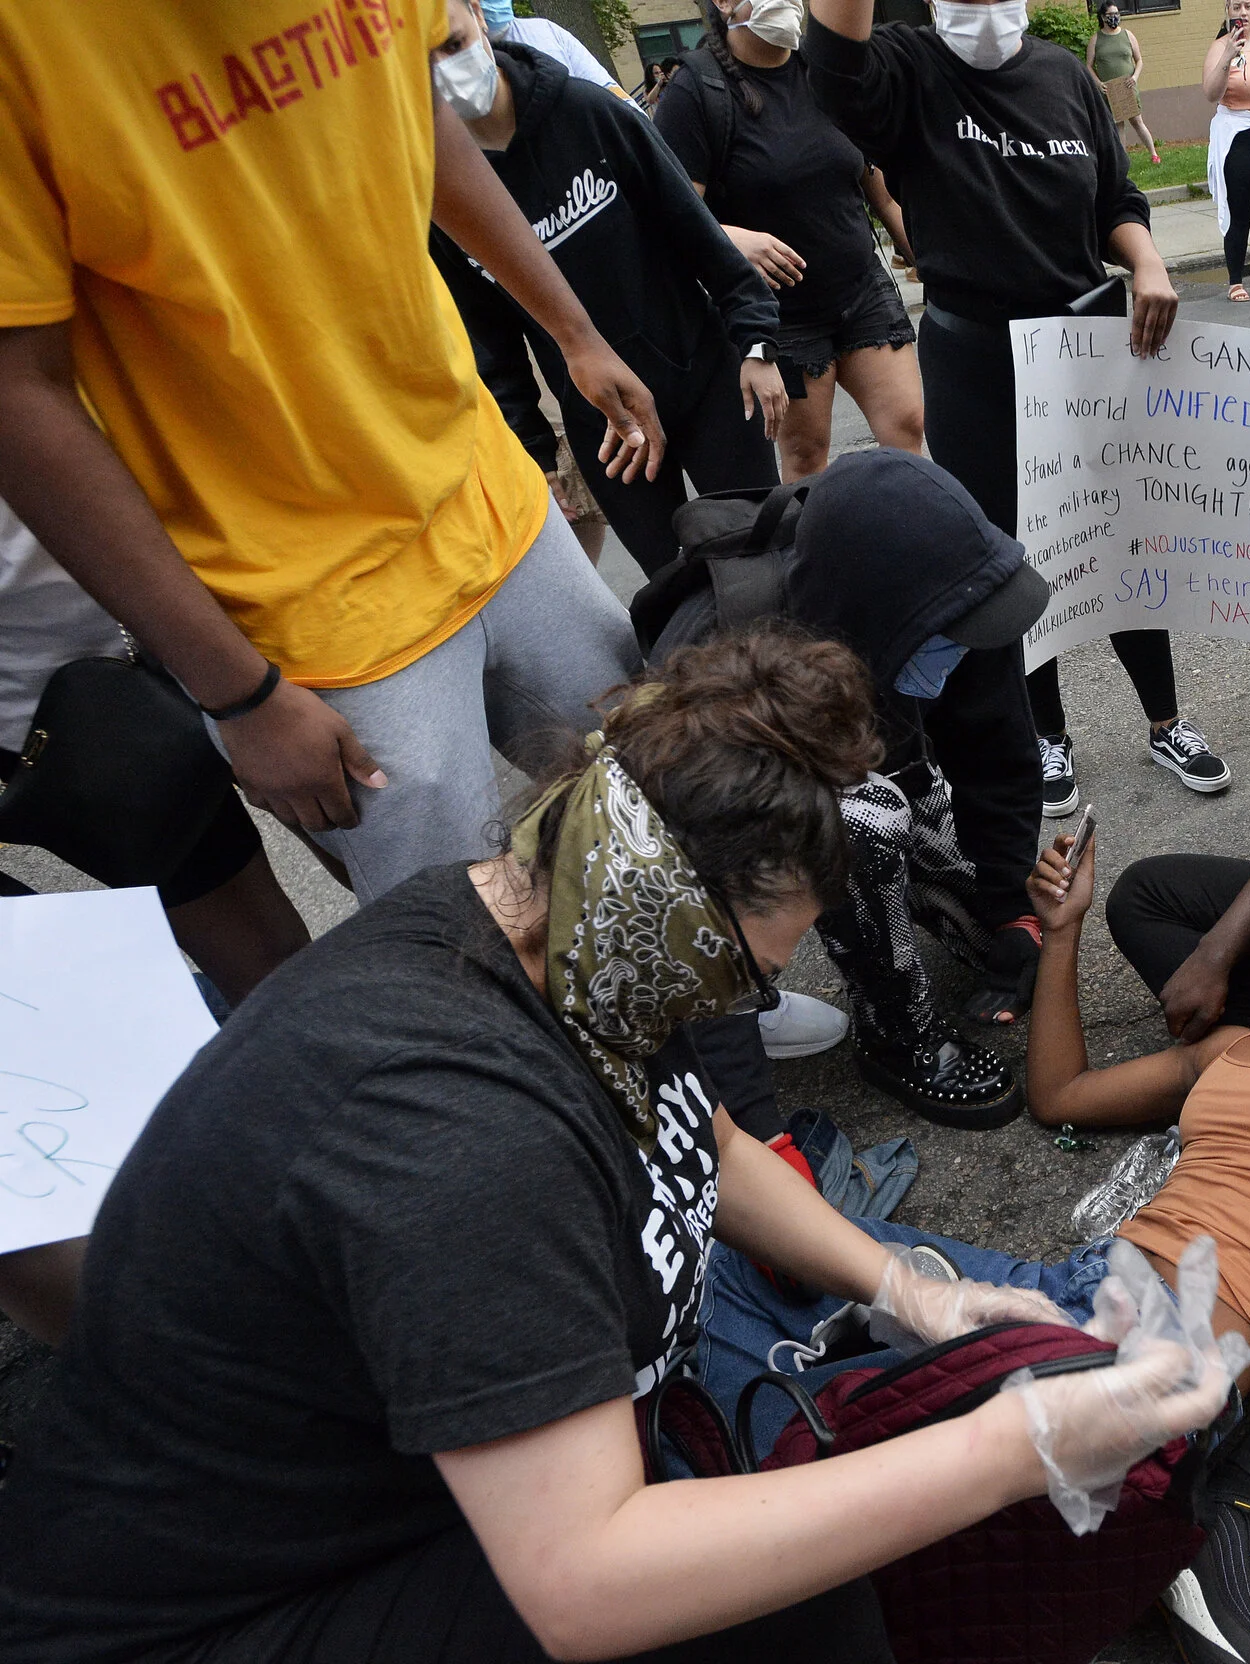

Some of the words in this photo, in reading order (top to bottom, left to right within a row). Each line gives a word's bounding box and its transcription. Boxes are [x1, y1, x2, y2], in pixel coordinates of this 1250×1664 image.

[1024, 328, 1041, 364] IF
[1059, 327, 1104, 359] ALL
[1125, 333, 1171, 361] te
[1024, 395, 1049, 419] the
[1065, 397, 1127, 421] world
[1073, 454, 1081, 469] a
[1027, 513, 1048, 533] the
